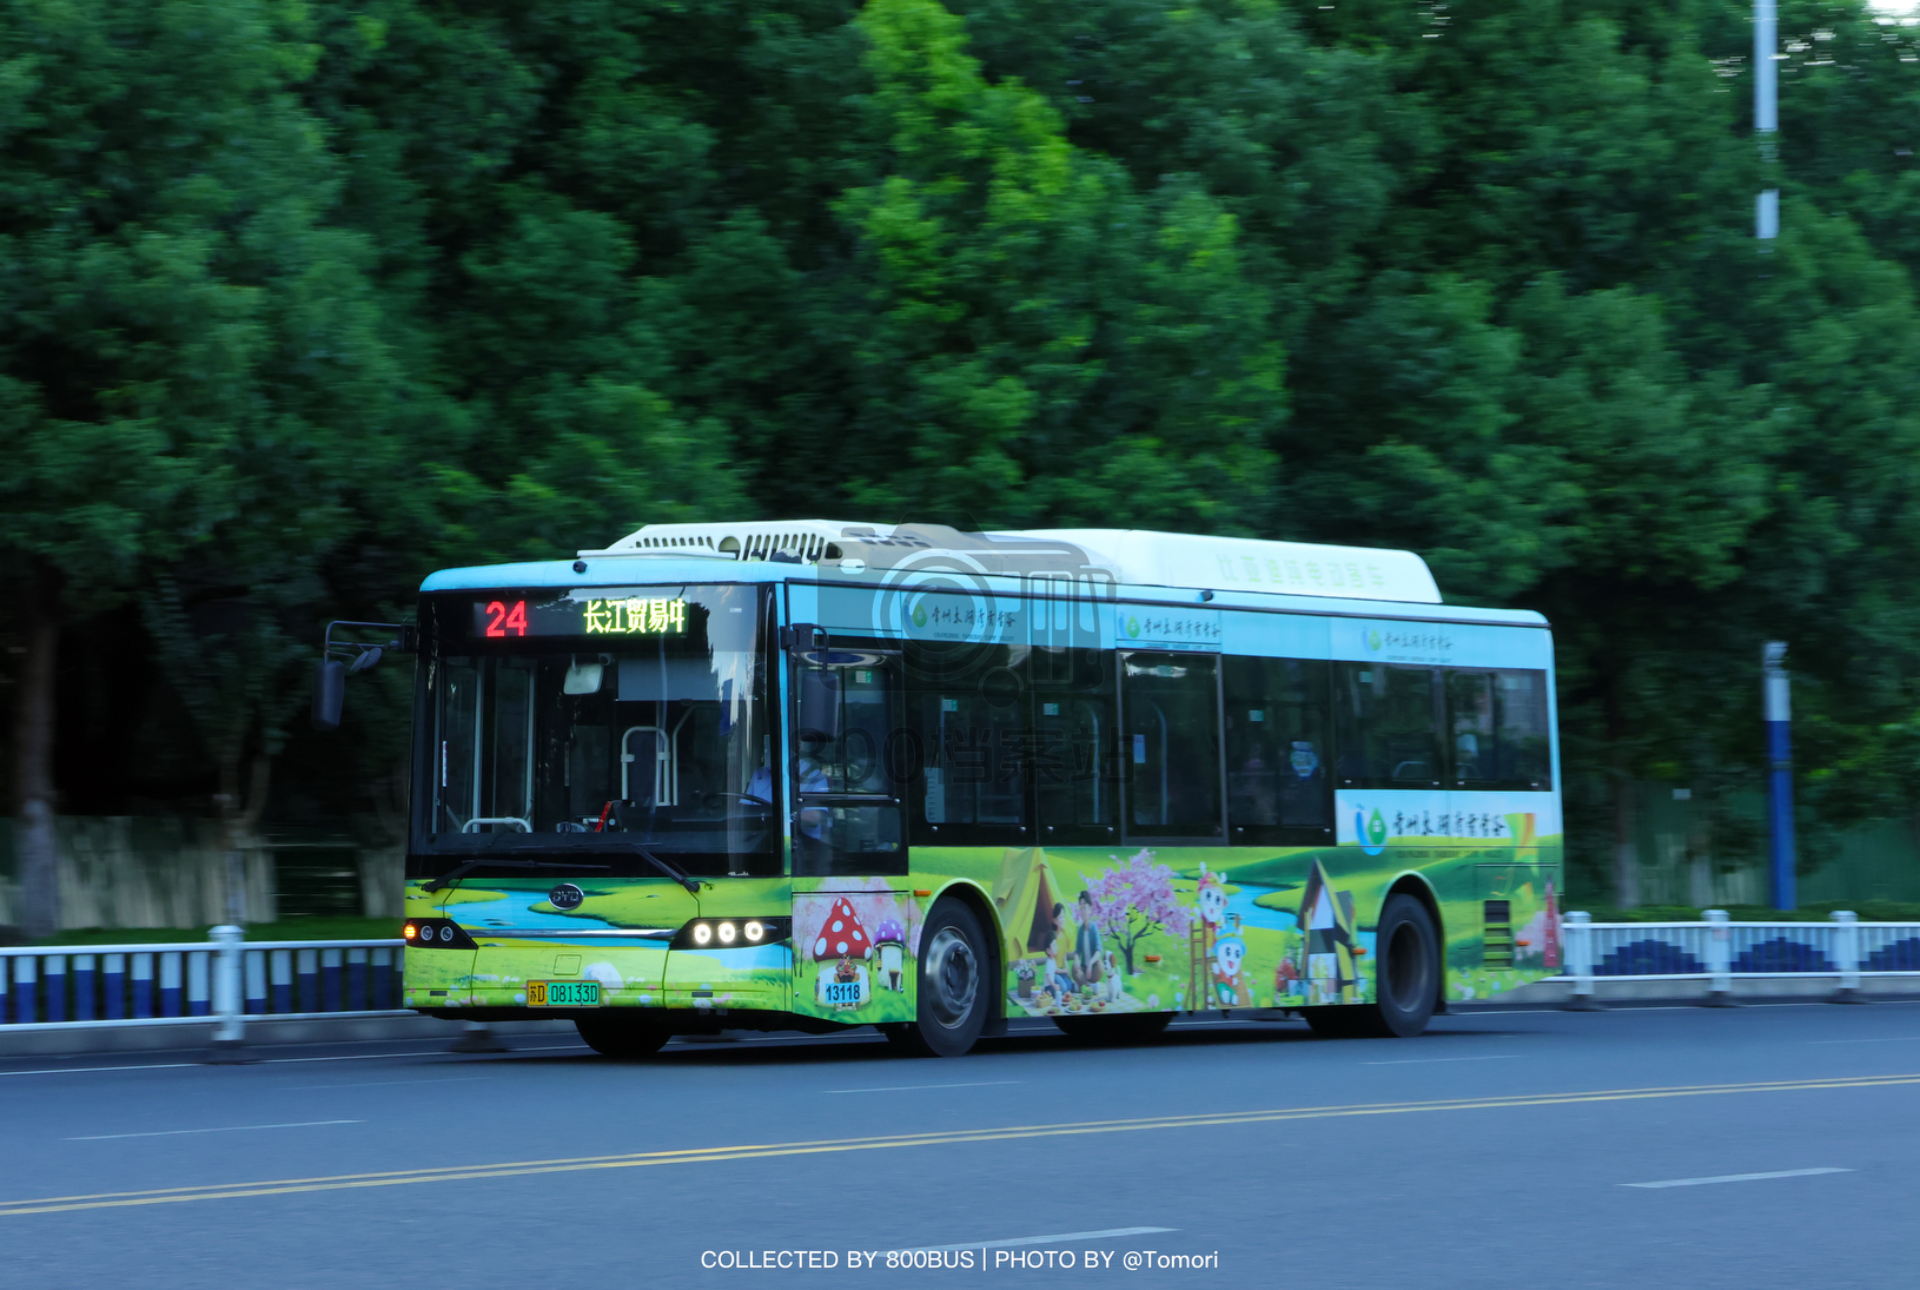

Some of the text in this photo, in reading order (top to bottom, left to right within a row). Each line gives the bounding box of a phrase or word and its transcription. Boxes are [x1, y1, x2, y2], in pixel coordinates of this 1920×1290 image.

[486, 600, 528, 637] 24
[551, 985, 598, 1002] 08133D
[826, 985, 861, 1001] 13118
